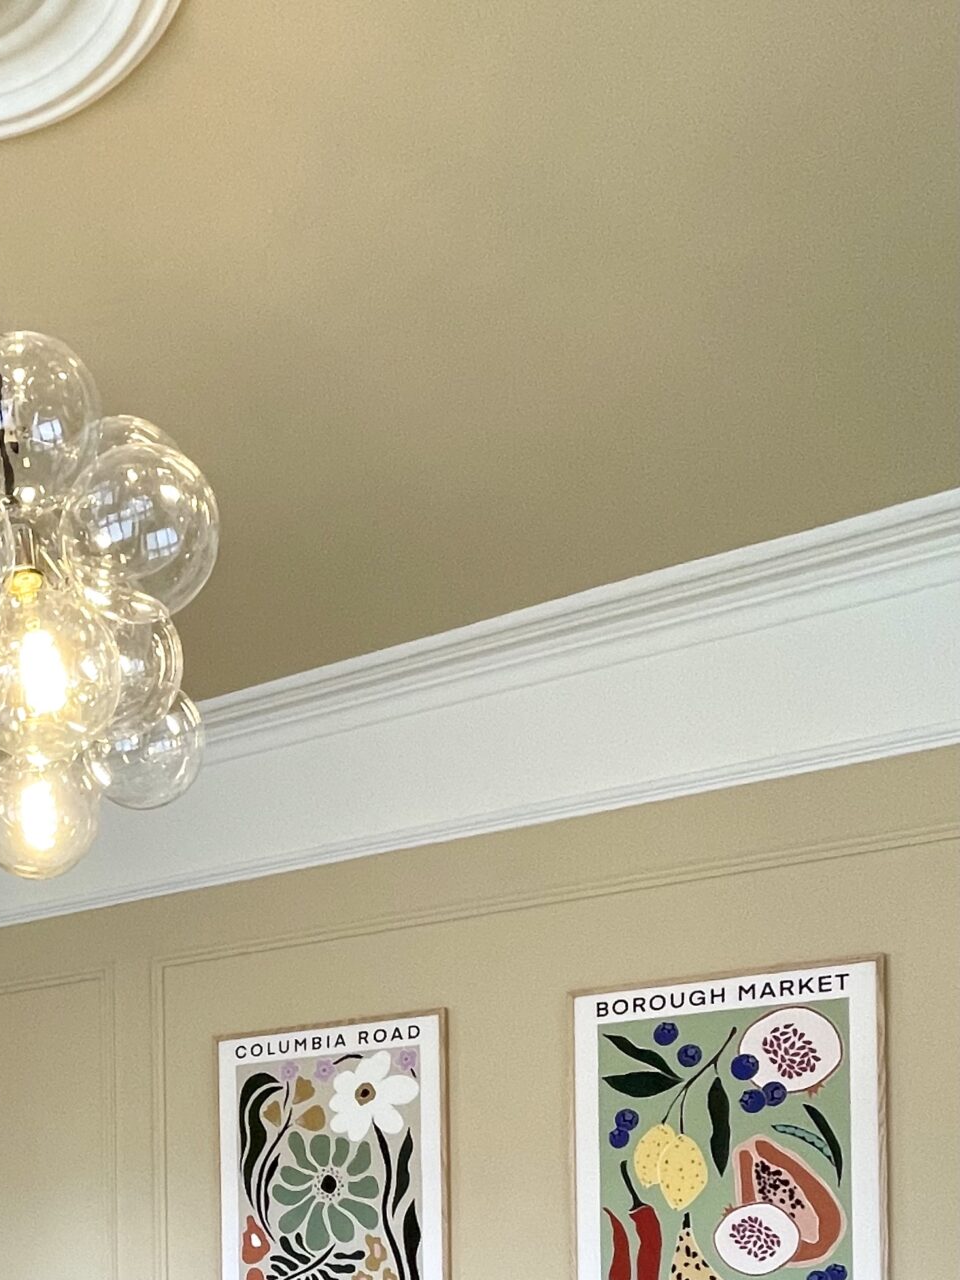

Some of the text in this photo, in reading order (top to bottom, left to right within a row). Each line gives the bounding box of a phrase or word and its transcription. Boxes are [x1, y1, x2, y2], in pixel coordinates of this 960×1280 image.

[596, 973, 850, 1017] BOROUGH MARKET
[235, 1025, 421, 1059] COLUMBIA ROAD
